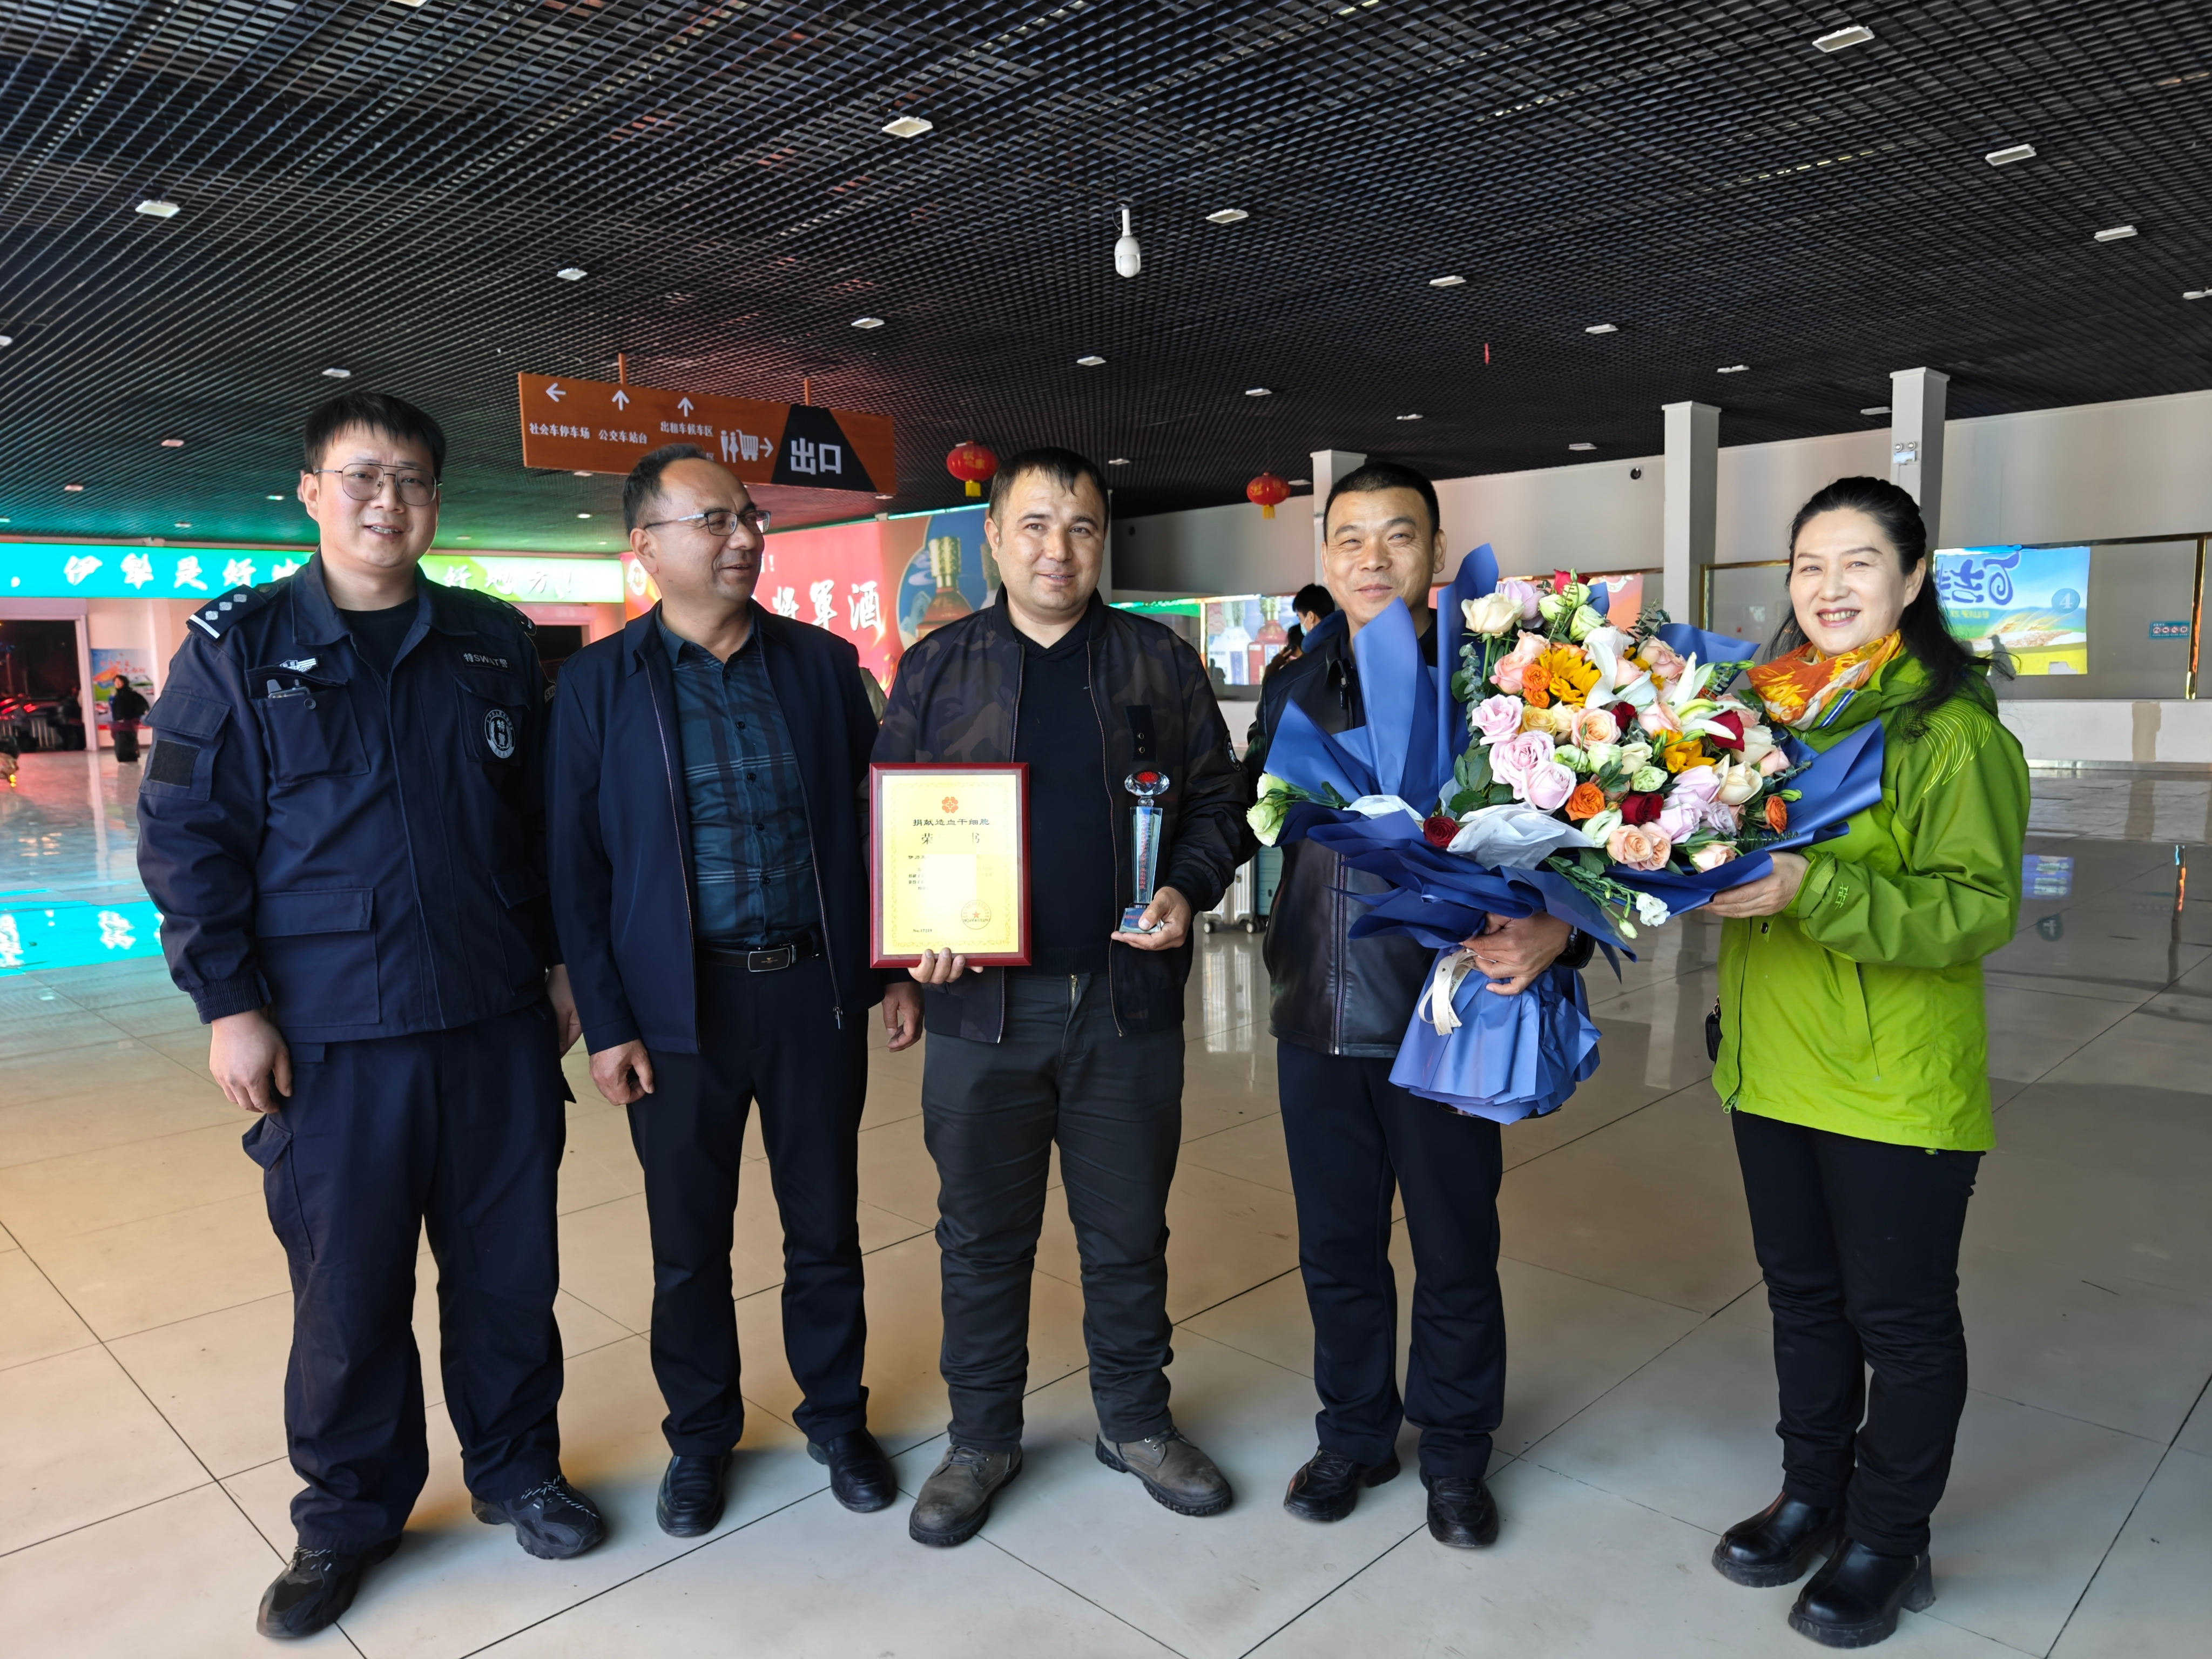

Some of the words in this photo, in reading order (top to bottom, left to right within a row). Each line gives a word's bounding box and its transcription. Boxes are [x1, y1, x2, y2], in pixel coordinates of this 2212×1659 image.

[529, 422, 590, 439] 社会车停车场
[598, 429, 648, 444] 公交车站台
[660, 421, 713, 437] 出租车候车区
[791, 437, 841, 475] 出口
[2059, 592, 2073, 609] 4
